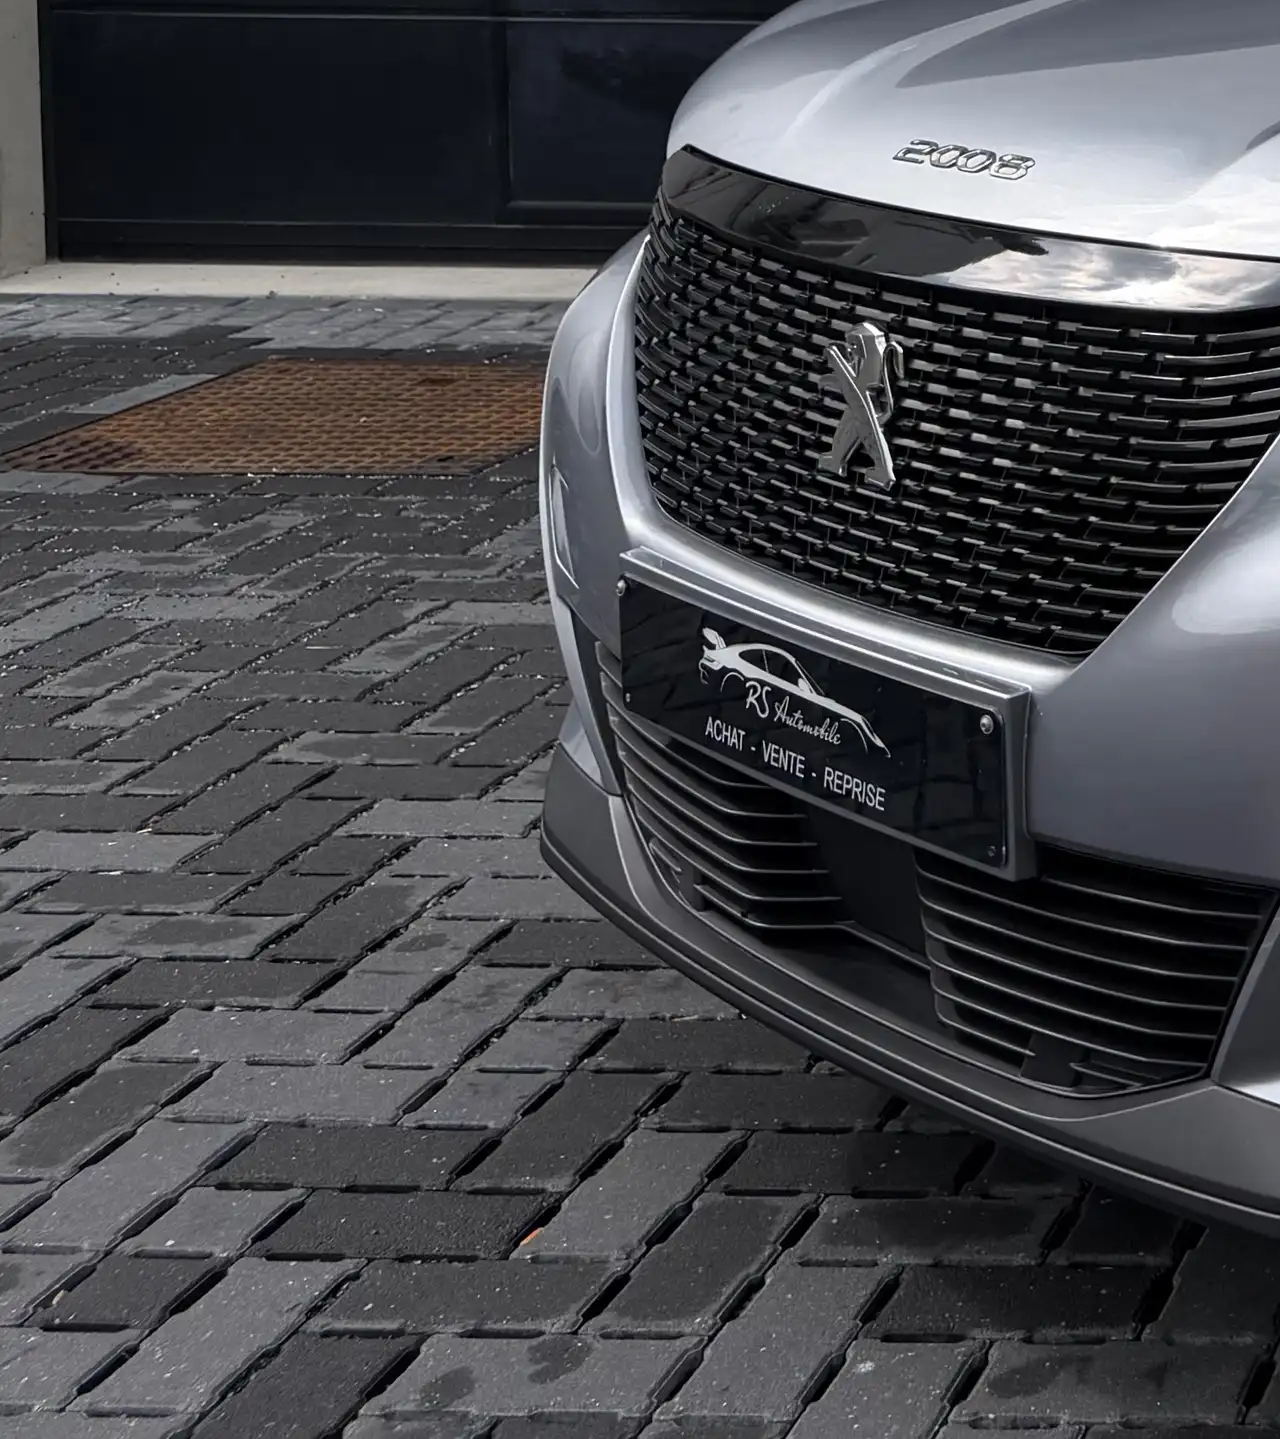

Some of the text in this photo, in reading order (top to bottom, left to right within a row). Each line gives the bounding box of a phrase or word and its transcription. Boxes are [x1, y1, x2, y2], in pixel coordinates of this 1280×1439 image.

[892, 138, 1036, 181] 2008
[745, 680, 842, 747] RS Automobile
[704, 716, 746, 752] ACHAT
[762, 739, 806, 778] VENTE
[823, 766, 887, 812] REPRISE
